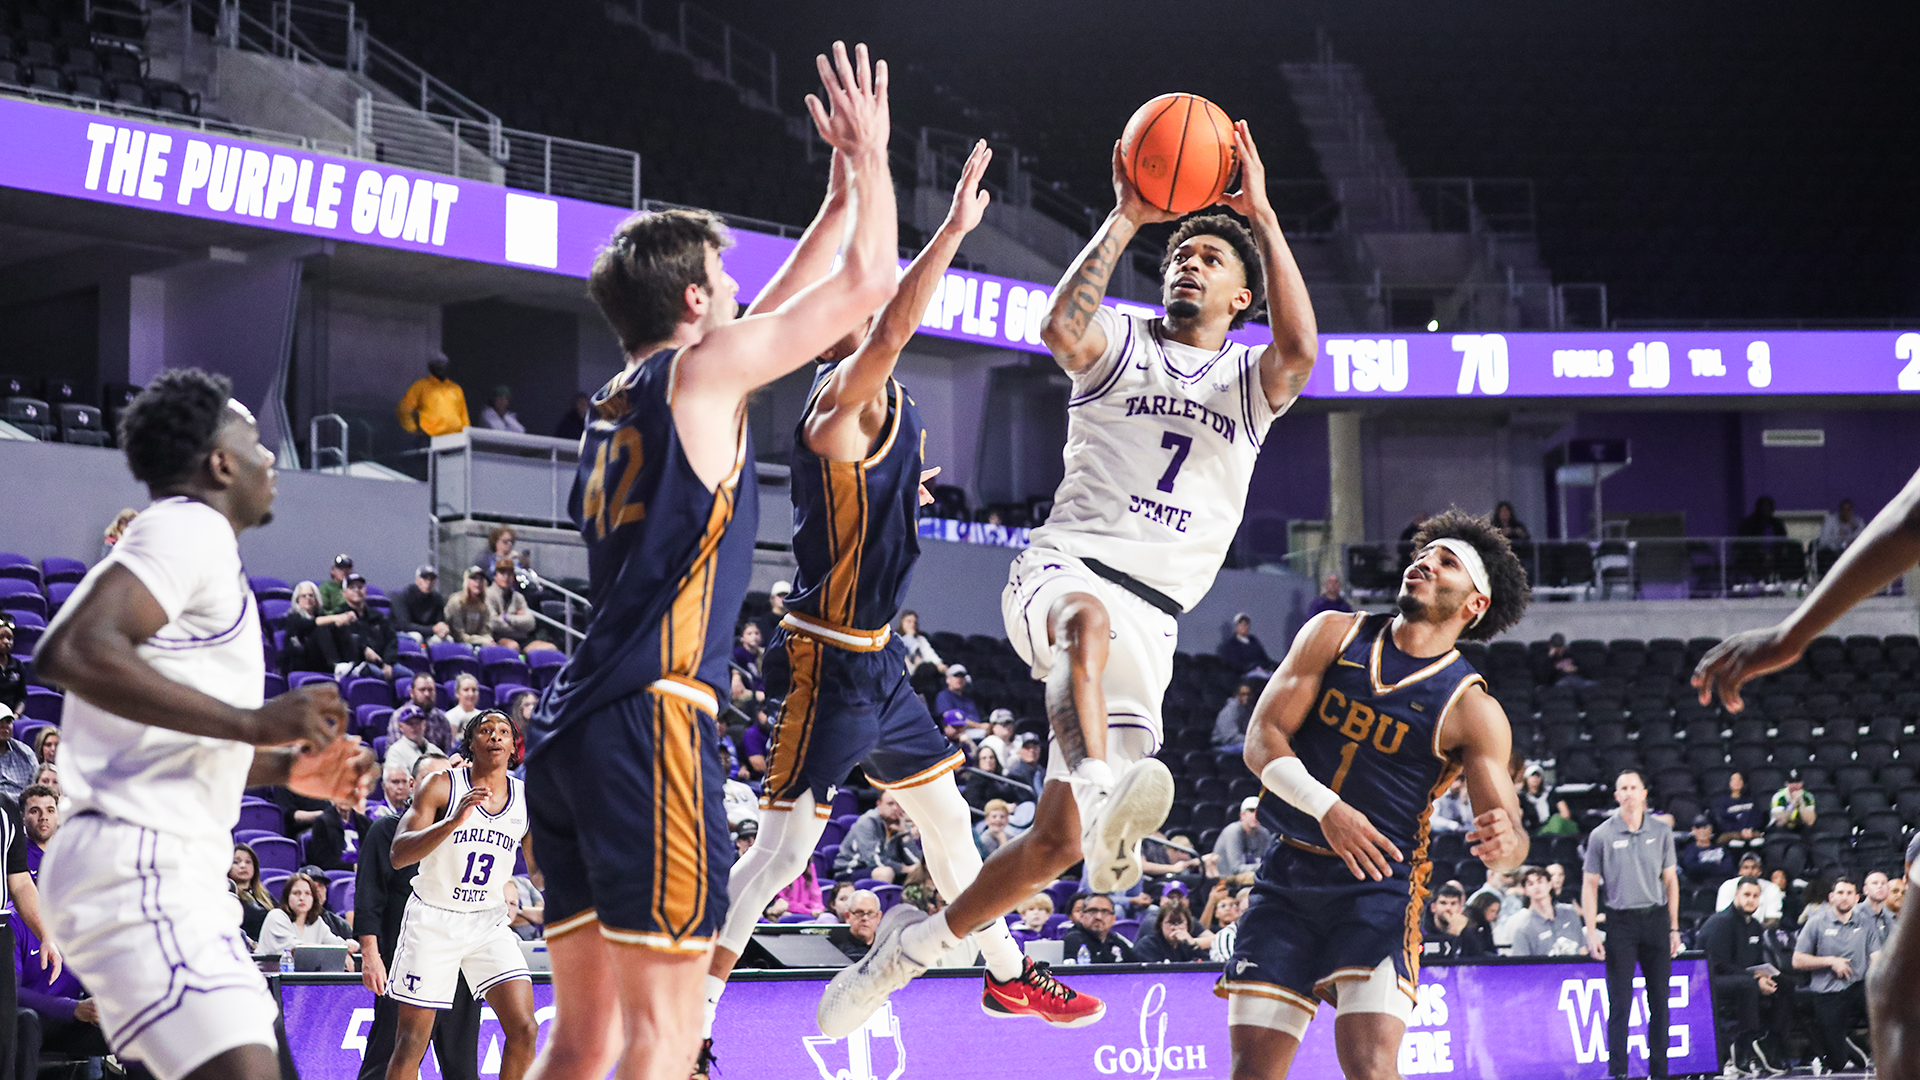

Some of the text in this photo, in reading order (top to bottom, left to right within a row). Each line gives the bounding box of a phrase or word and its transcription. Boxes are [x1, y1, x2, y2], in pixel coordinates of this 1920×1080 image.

[85, 122, 459, 246] THE PURPLE GOAT
[1325, 339, 1409, 392] TSU
[1451, 333, 1510, 395] 70
[1627, 341, 1670, 388] 10
[1746, 340, 1772, 388] 3
[1125, 395, 1236, 444] TARLETON
[583, 426, 646, 540] 42
[1157, 430, 1193, 494] 7
[1128, 494, 1192, 533] STATE
[1318, 688, 1410, 754] CBU
[1331, 741, 1359, 796] 1
[453, 828, 516, 853] TARLETON
[452, 887, 488, 903] STATE
[461, 851, 495, 886] 13
